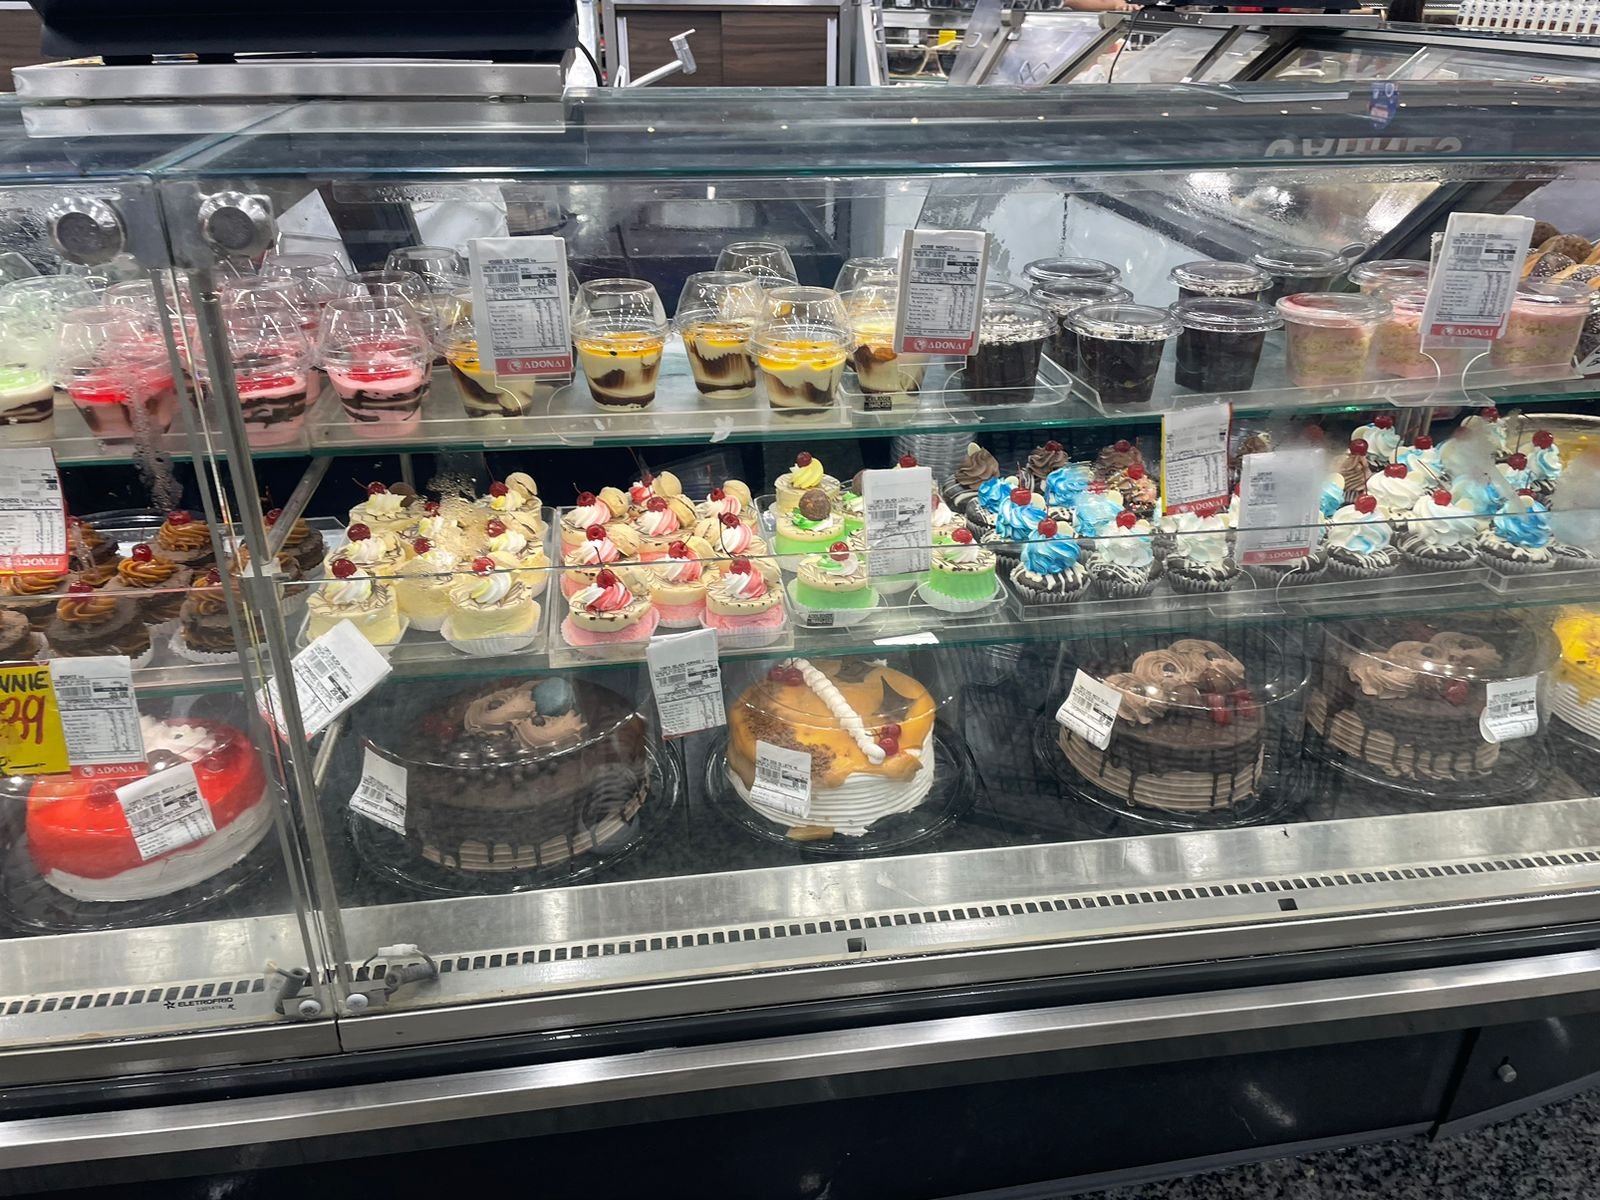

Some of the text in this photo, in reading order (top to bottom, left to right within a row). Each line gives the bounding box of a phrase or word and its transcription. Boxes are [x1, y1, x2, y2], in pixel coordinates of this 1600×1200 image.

[1456, 328, 1494, 336] ADONAI
[928, 341, 966, 350] ADONAI
[524, 360, 566, 369] ADONAI
[1268, 551, 1305, 560] ADONAI
[96, 765, 139, 775] ADONAI
[178, 997, 233, 1007] ELETROFRIO
